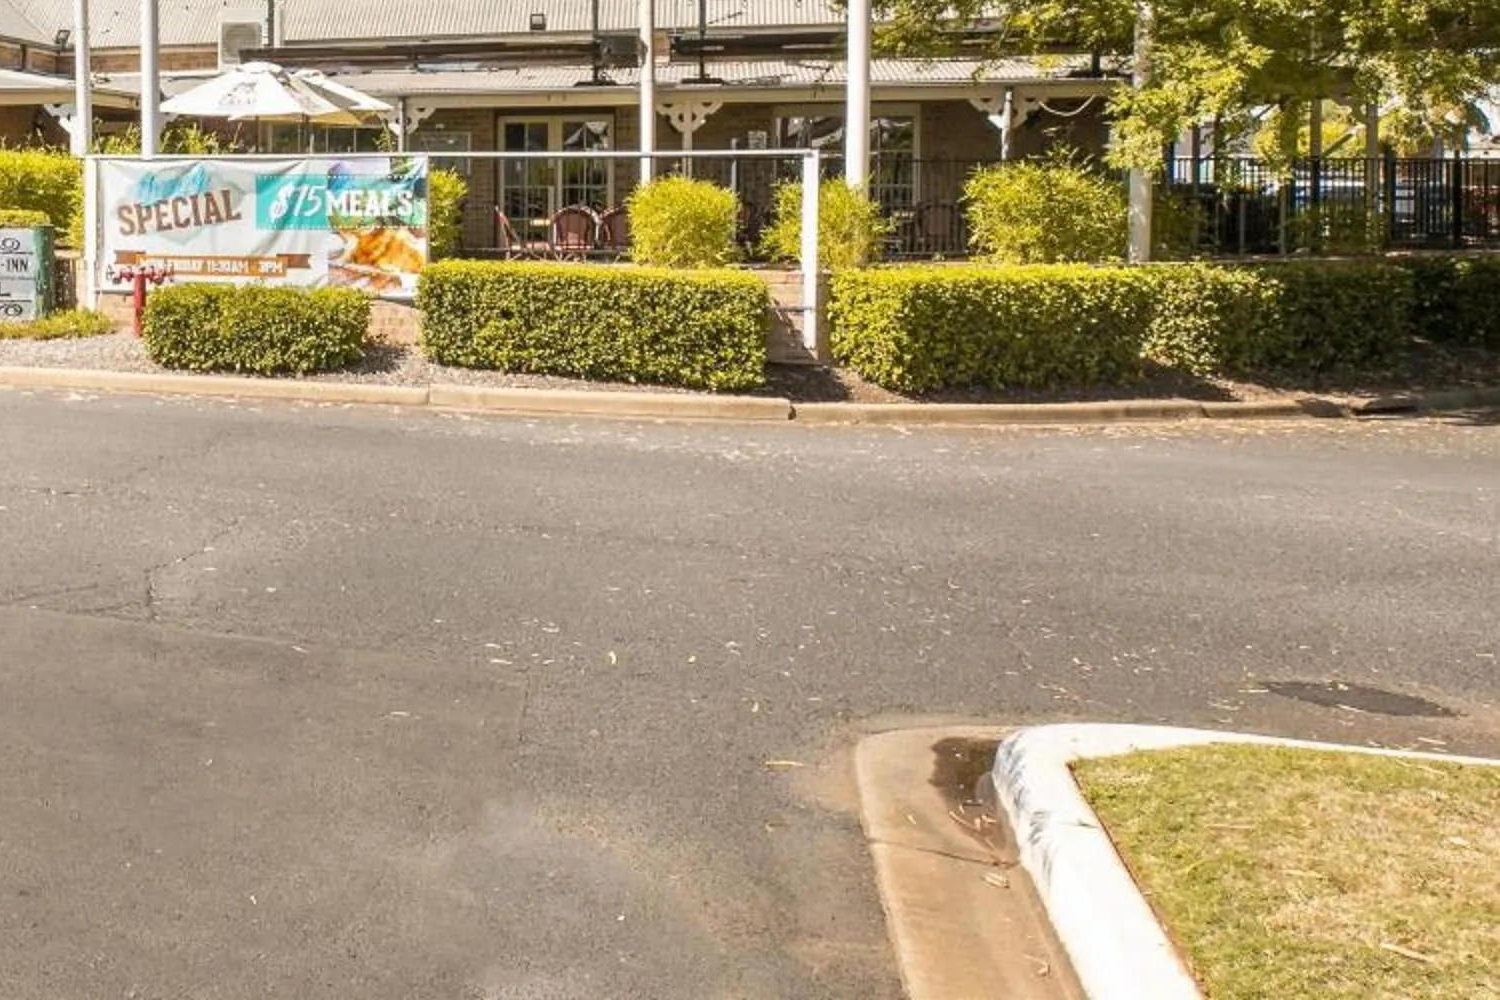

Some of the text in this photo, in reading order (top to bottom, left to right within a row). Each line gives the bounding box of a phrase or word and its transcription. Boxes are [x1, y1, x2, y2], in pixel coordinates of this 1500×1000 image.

[117, 189, 242, 236] SPECIAL
[270, 182, 413, 221] $15 MEALS
